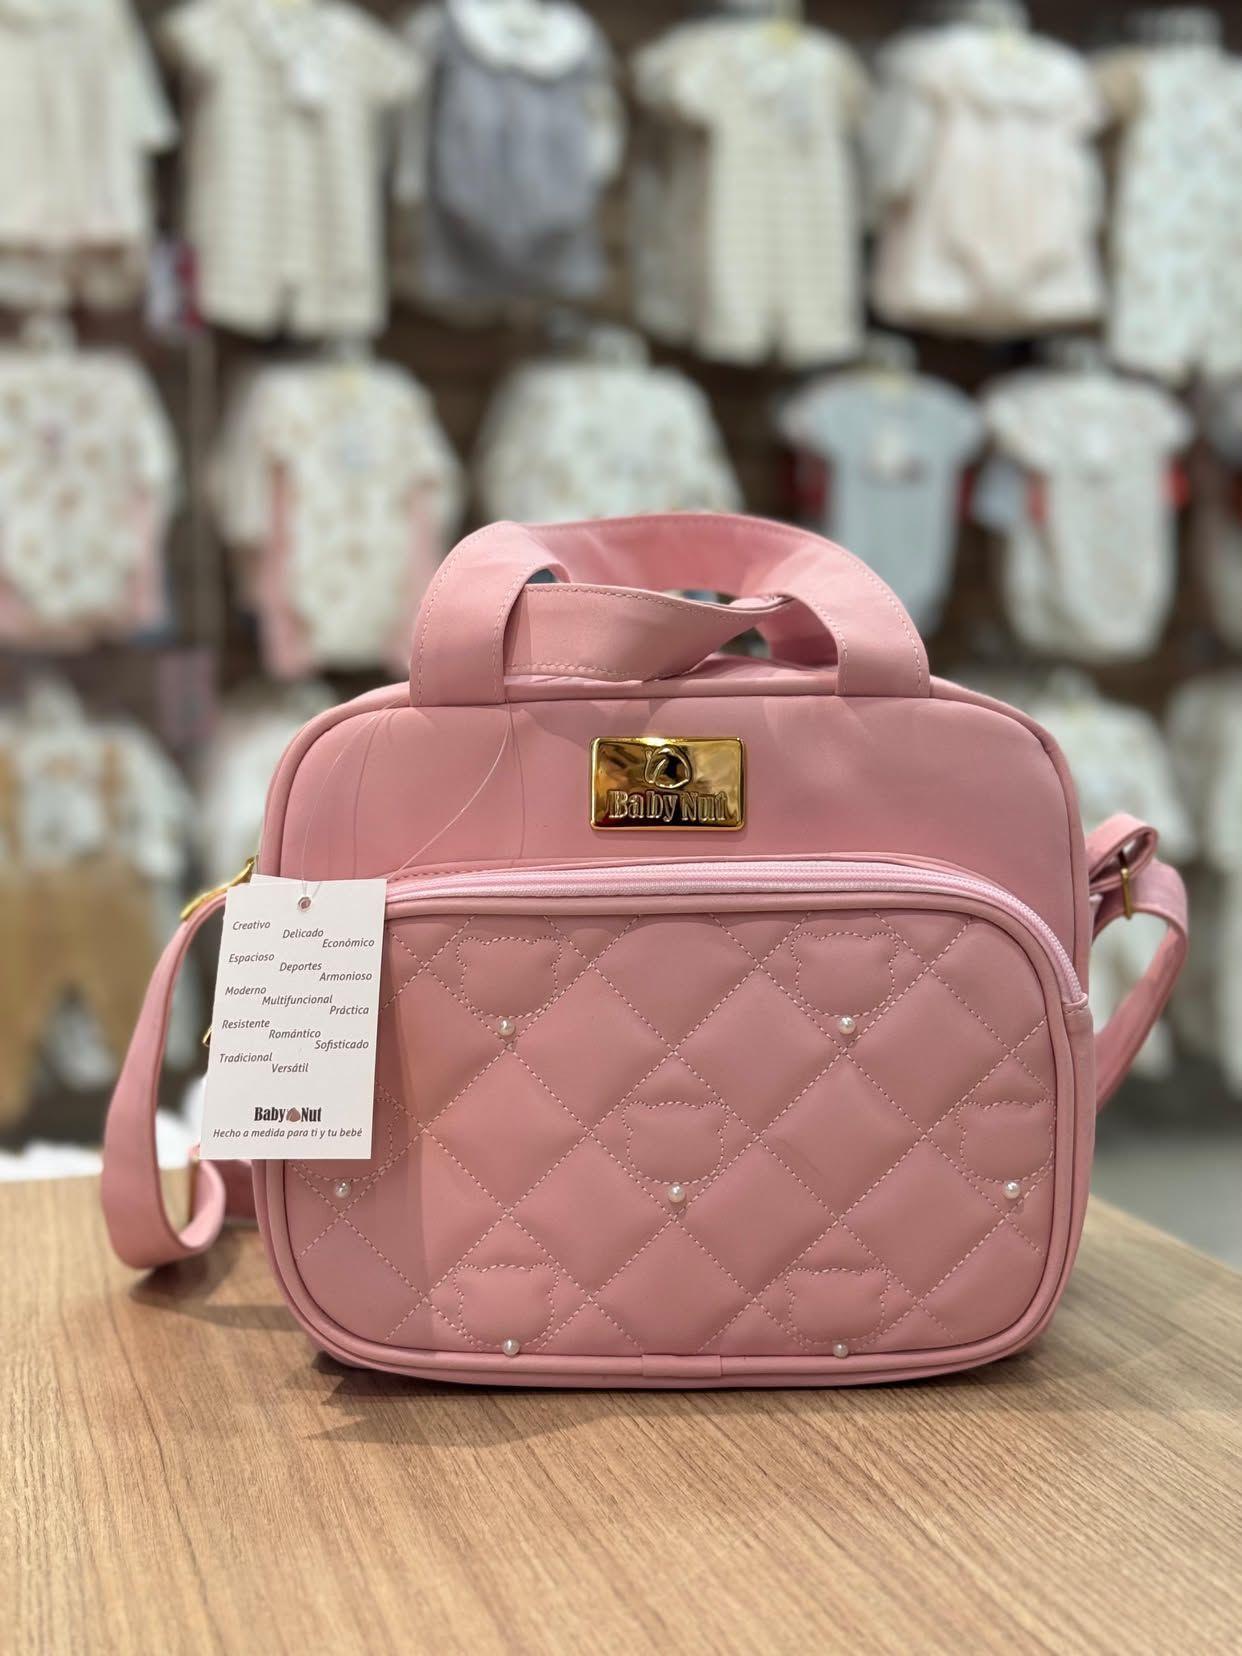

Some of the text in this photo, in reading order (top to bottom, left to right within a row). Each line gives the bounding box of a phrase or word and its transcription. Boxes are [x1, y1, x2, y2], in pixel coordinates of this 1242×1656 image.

[609, 790, 727, 822] Baby Nut
[233, 921, 271, 930] Creativo
[283, 928, 324, 938] Delicado
[322, 938, 374, 948] Económico
[229, 952, 274, 963] Espacioso
[280, 962, 322, 973] Deportes
[319, 972, 372, 981] Armonioso
[225, 986, 266, 995] Moderno
[262, 995, 332, 1007] Multifuncional
[330, 1006, 369, 1015] Práctica
[222, 1020, 270, 1029] Resistente
[269, 1029, 321, 1039] Romántico
[314, 1040, 369, 1051] Sofisticado
[220, 1053, 272, 1063] Tradicional
[272, 1063, 309, 1072] Versátil
[254, 1107, 322, 1122] Baby Nut
[213, 1129, 241, 1138] Hecho
[251, 1128, 285, 1137] medida
[287, 1130, 308, 1139] para
[311, 1128, 318, 1137] ti
[320, 1130, 325, 1139] y
[328, 1129, 337, 1137] tu
[340, 1128, 362, 1137] bebé
